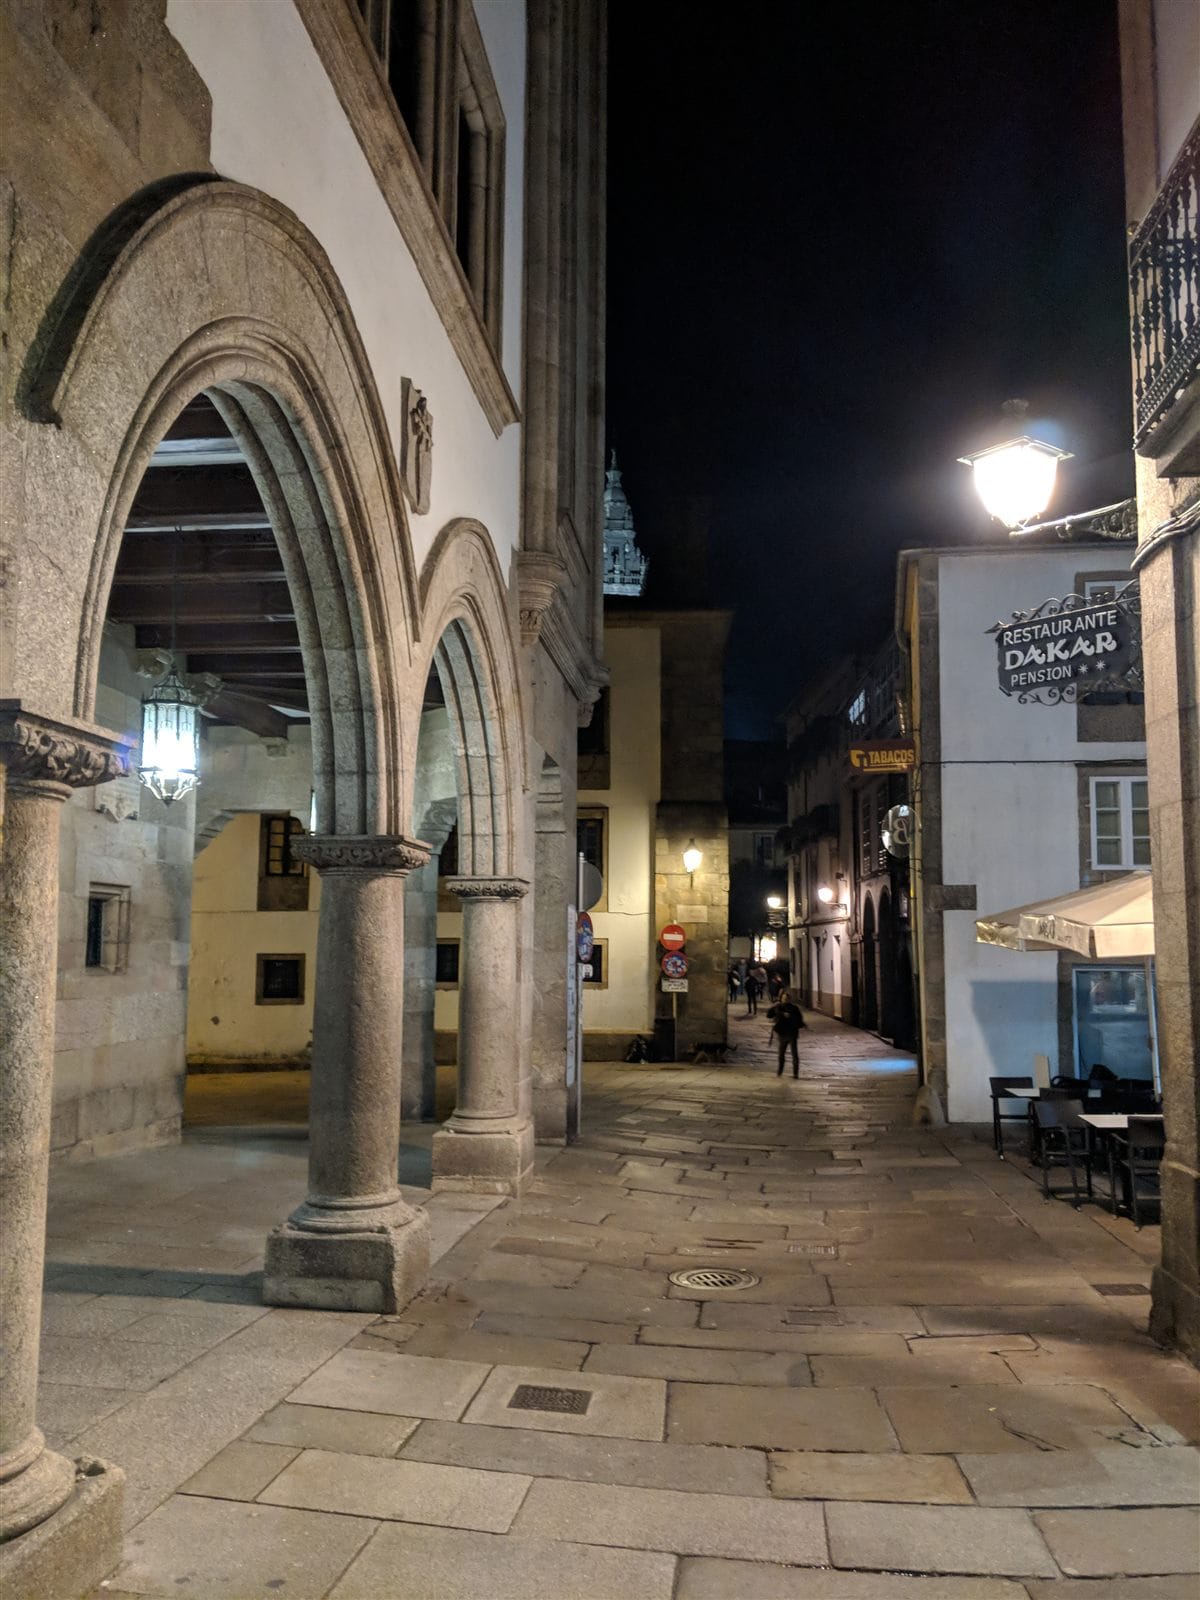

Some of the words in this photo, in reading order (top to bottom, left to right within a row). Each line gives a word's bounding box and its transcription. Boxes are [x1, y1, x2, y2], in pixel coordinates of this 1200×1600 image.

[1003, 610, 1117, 646] RESTAURANTE
[1004, 632, 1117, 671] DAKAR
[1011, 665, 1072, 687] PENSION
[868, 749, 914, 764] TABACOS
